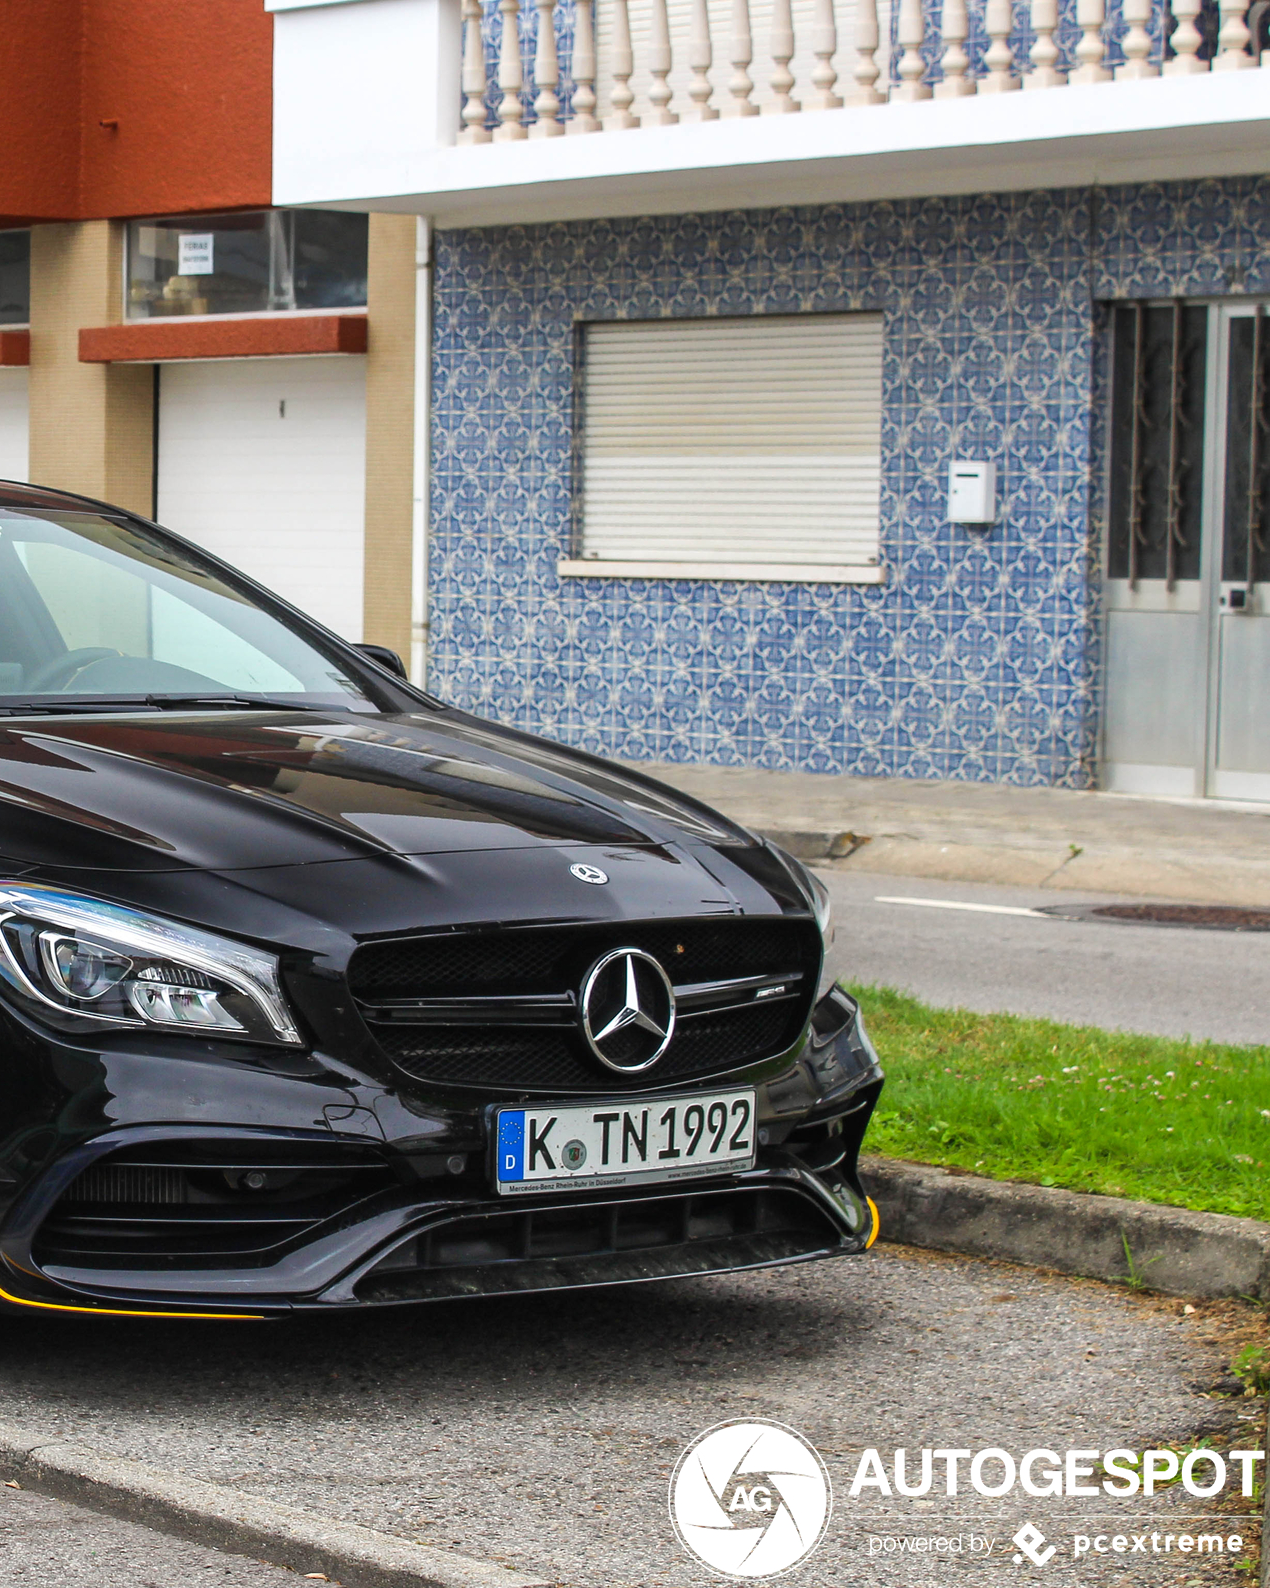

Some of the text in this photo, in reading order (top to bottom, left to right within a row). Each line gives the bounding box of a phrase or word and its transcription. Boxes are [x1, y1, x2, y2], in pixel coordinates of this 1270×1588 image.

[529, 1116, 557, 1171] K
[505, 1154, 516, 1170] D
[509, 1182, 555, 1192] Mercedes-Benz
[596, 1177, 627, 1186] Düsseldorf
